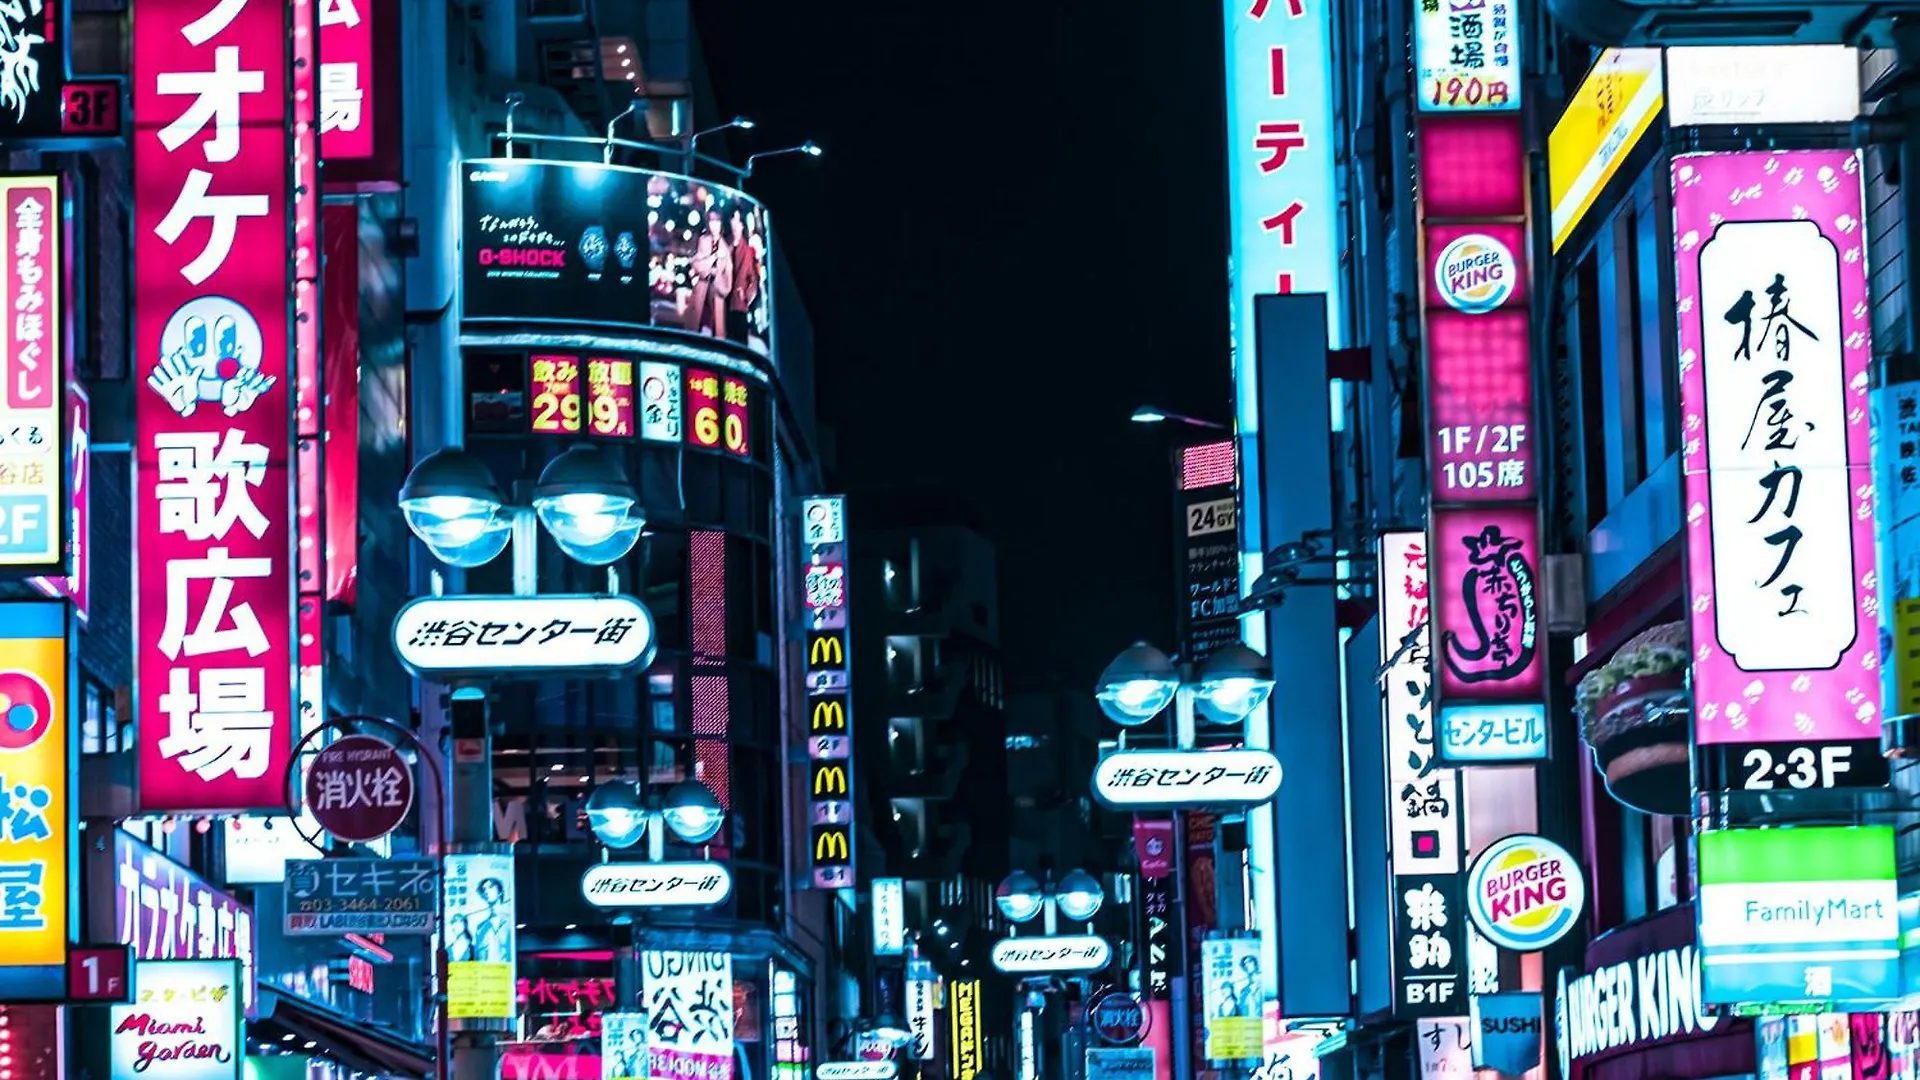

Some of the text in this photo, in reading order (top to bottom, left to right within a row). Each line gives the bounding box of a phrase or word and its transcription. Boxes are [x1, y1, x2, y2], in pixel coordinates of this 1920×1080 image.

[1449, 13, 1485, 69] 酒場
[1432, 77, 1508, 106] 190円
[69, 90, 110, 126] 3F
[478, 248, 567, 267] G-SHOCK
[1448, 252, 1500, 278] BURGER
[1450, 266, 1504, 294] KING
[15, 196, 46, 400] 全身もみほぐし
[1724, 273, 1820, 617] 椿屋カフェ
[1443, 459, 1525, 489] 105席
[1191, 505, 1215, 532] 24
[154, 427, 274, 782] 歌広場
[408, 618, 638, 647] 渋谷センター街
[1443, 718, 1543, 748] センタービル
[316, 767, 403, 810] 消火栓
[1108, 765, 1273, 787] 渋谷センター街
[590, 875, 722, 893] 渋谷センター街
[1487, 860, 1562, 898] BURGER
[1491, 877, 1567, 923] KING
[1746, 900, 1884, 926] FamilyMart
[82, 956, 120, 994] 1F
[1406, 983, 1455, 1003] B1F
[115, 1013, 206, 1036] Miami
[1422, 1022, 1472, 1052] すし
[1483, 1017, 1542, 1034] SUSHI
